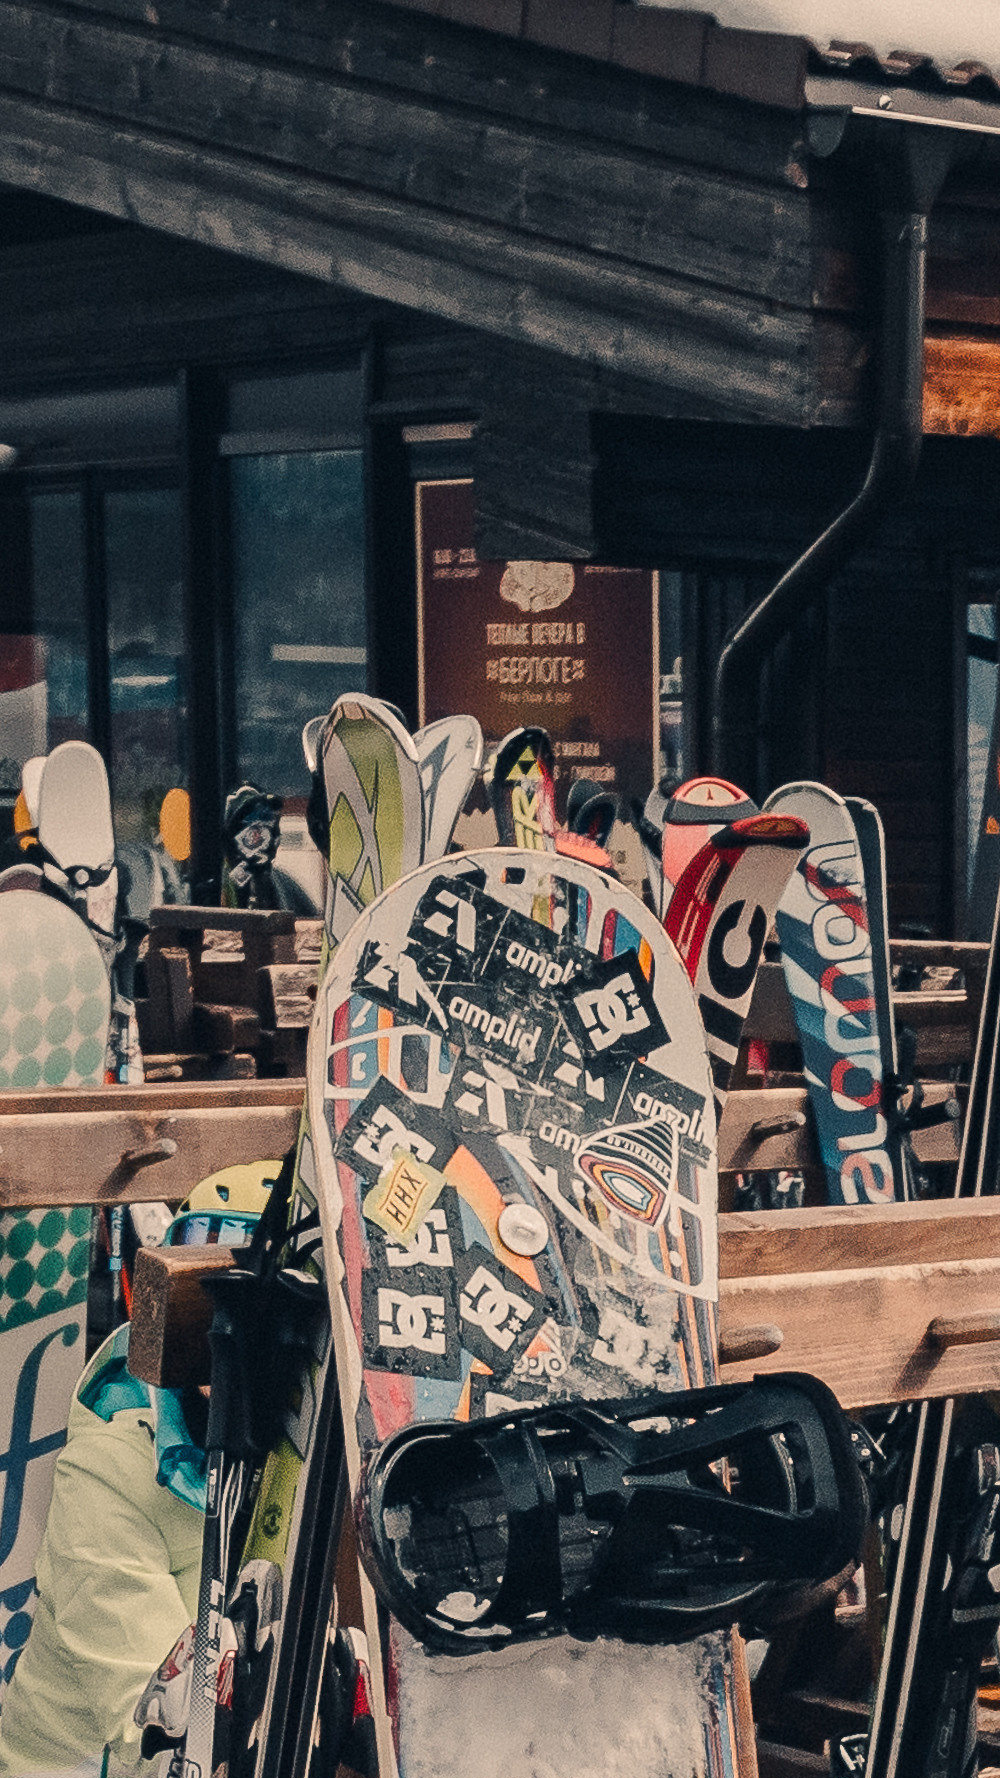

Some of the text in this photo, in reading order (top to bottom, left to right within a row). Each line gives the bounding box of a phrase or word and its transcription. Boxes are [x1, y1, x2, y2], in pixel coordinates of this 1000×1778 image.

[448, 996, 543, 1064] amplid
[573, 972, 651, 1051] DC
[806, 841, 897, 1205] alomon
[377, 1287, 447, 1355] DC
[459, 1264, 535, 1352] DC
